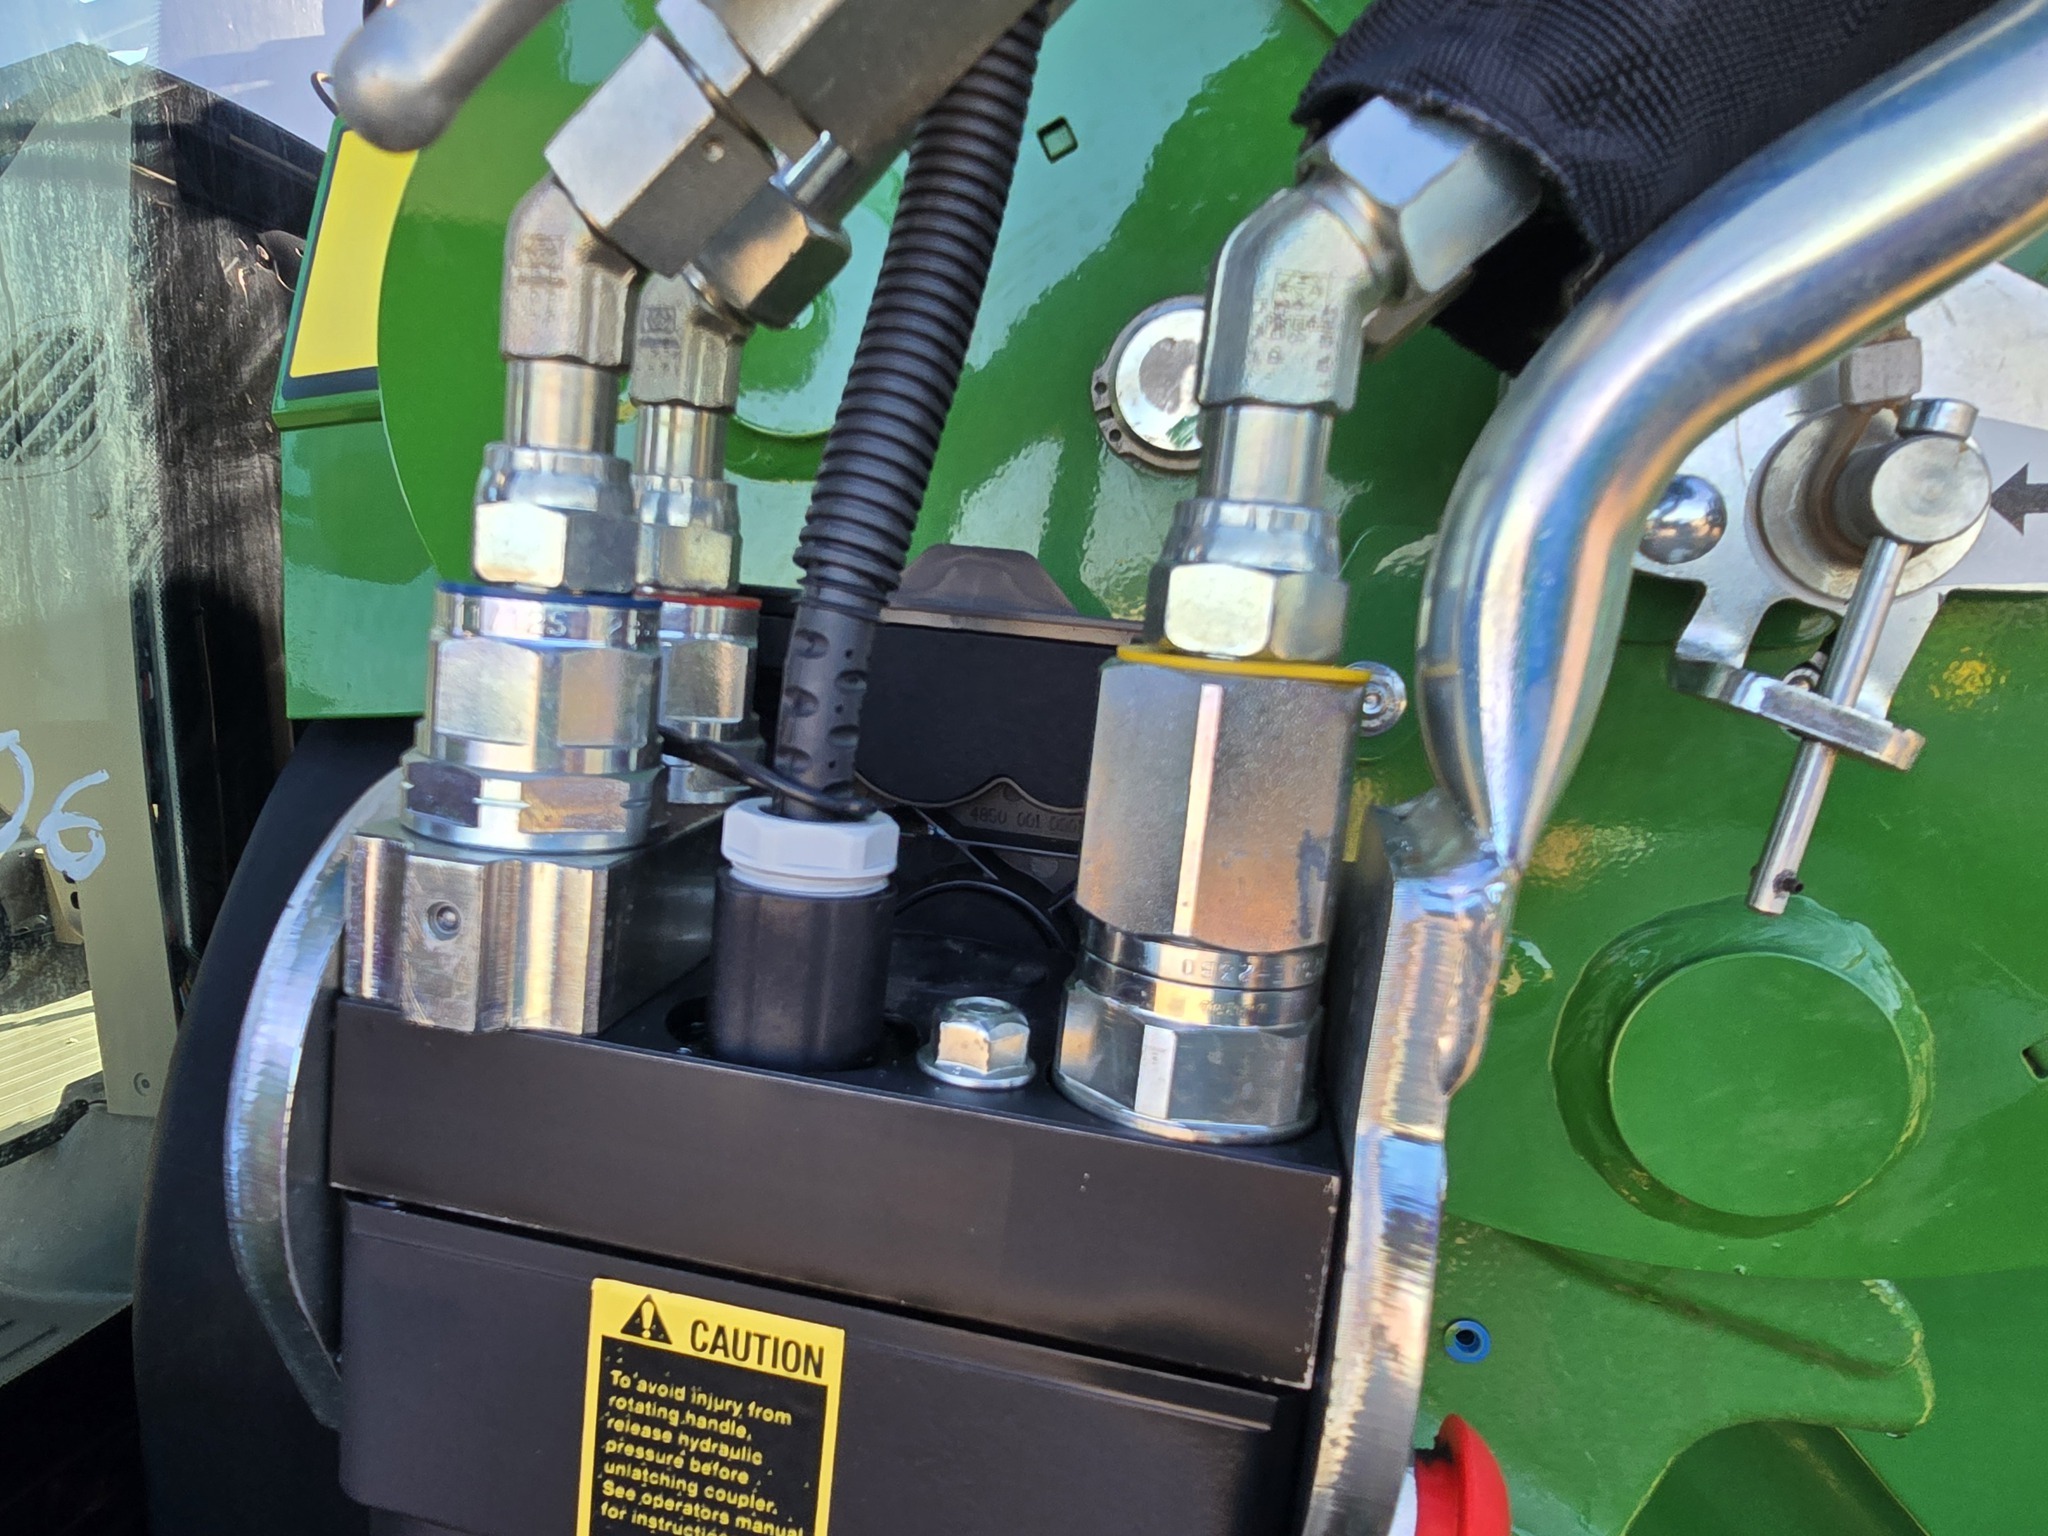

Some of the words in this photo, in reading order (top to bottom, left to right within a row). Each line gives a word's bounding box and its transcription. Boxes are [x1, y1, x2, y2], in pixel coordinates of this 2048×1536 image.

[690, 1319, 824, 1379] CAUTION
[608, 1394, 680, 1427] rotating
[610, 1369, 632, 1389] To
[636, 1378, 686, 1402] avoid
[691, 1389, 743, 1417] injury
[747, 1400, 793, 1426] from
[604, 1438, 684, 1470] pressure
[689, 1456, 750, 1486] before
[606, 1416, 673, 1444] release
[678, 1431, 764, 1466] hydraulic
[603, 1460, 699, 1499] unlatching
[600, 1501, 627, 1521] for
[602, 1478, 637, 1502] See
[640, 1492, 730, 1526] operators
[734, 1515, 804, 1536] manual
